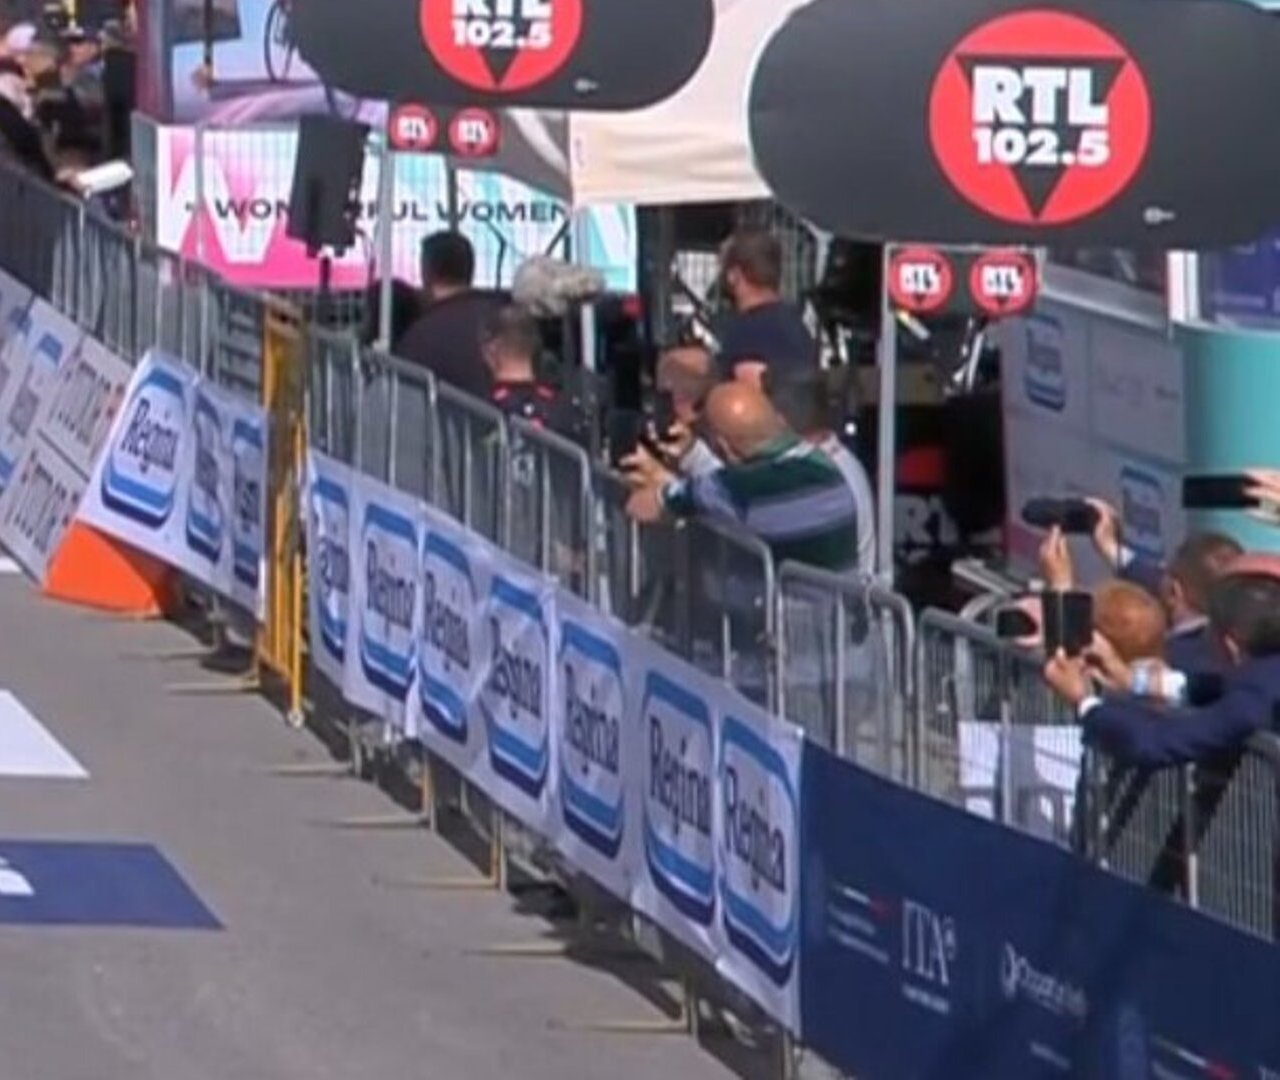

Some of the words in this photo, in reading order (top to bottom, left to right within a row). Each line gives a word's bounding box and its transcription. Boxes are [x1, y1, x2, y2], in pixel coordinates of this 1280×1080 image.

[451, 21, 553, 49] 102.5
[972, 67, 1109, 125] RTL
[972, 128, 1110, 167] 102.5
